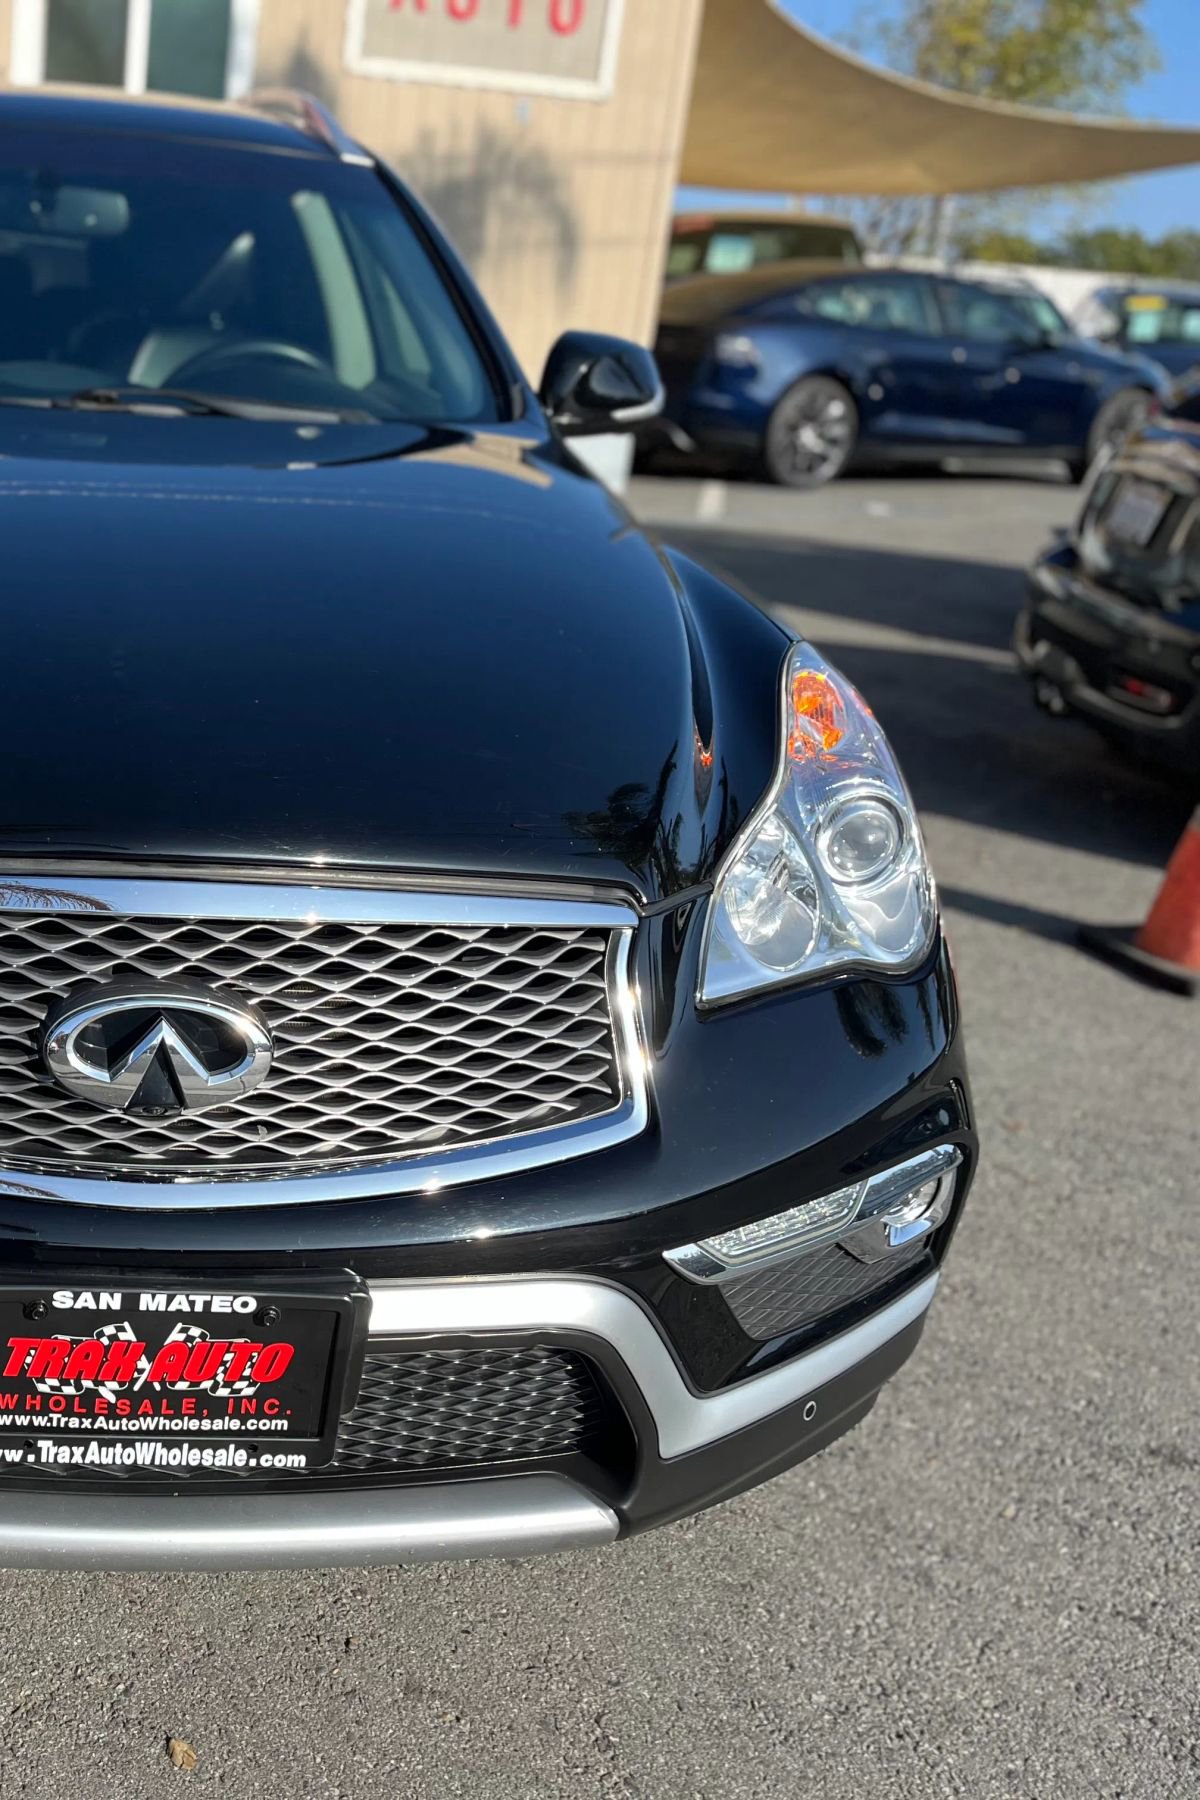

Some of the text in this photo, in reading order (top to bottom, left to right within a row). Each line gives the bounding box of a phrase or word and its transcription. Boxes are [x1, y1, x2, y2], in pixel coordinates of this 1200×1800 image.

[51, 1289, 258, 1314] SAN MATEO
[2, 1336, 295, 1383] TRAX AUTO
[227, 1397, 292, 1416] INC.
